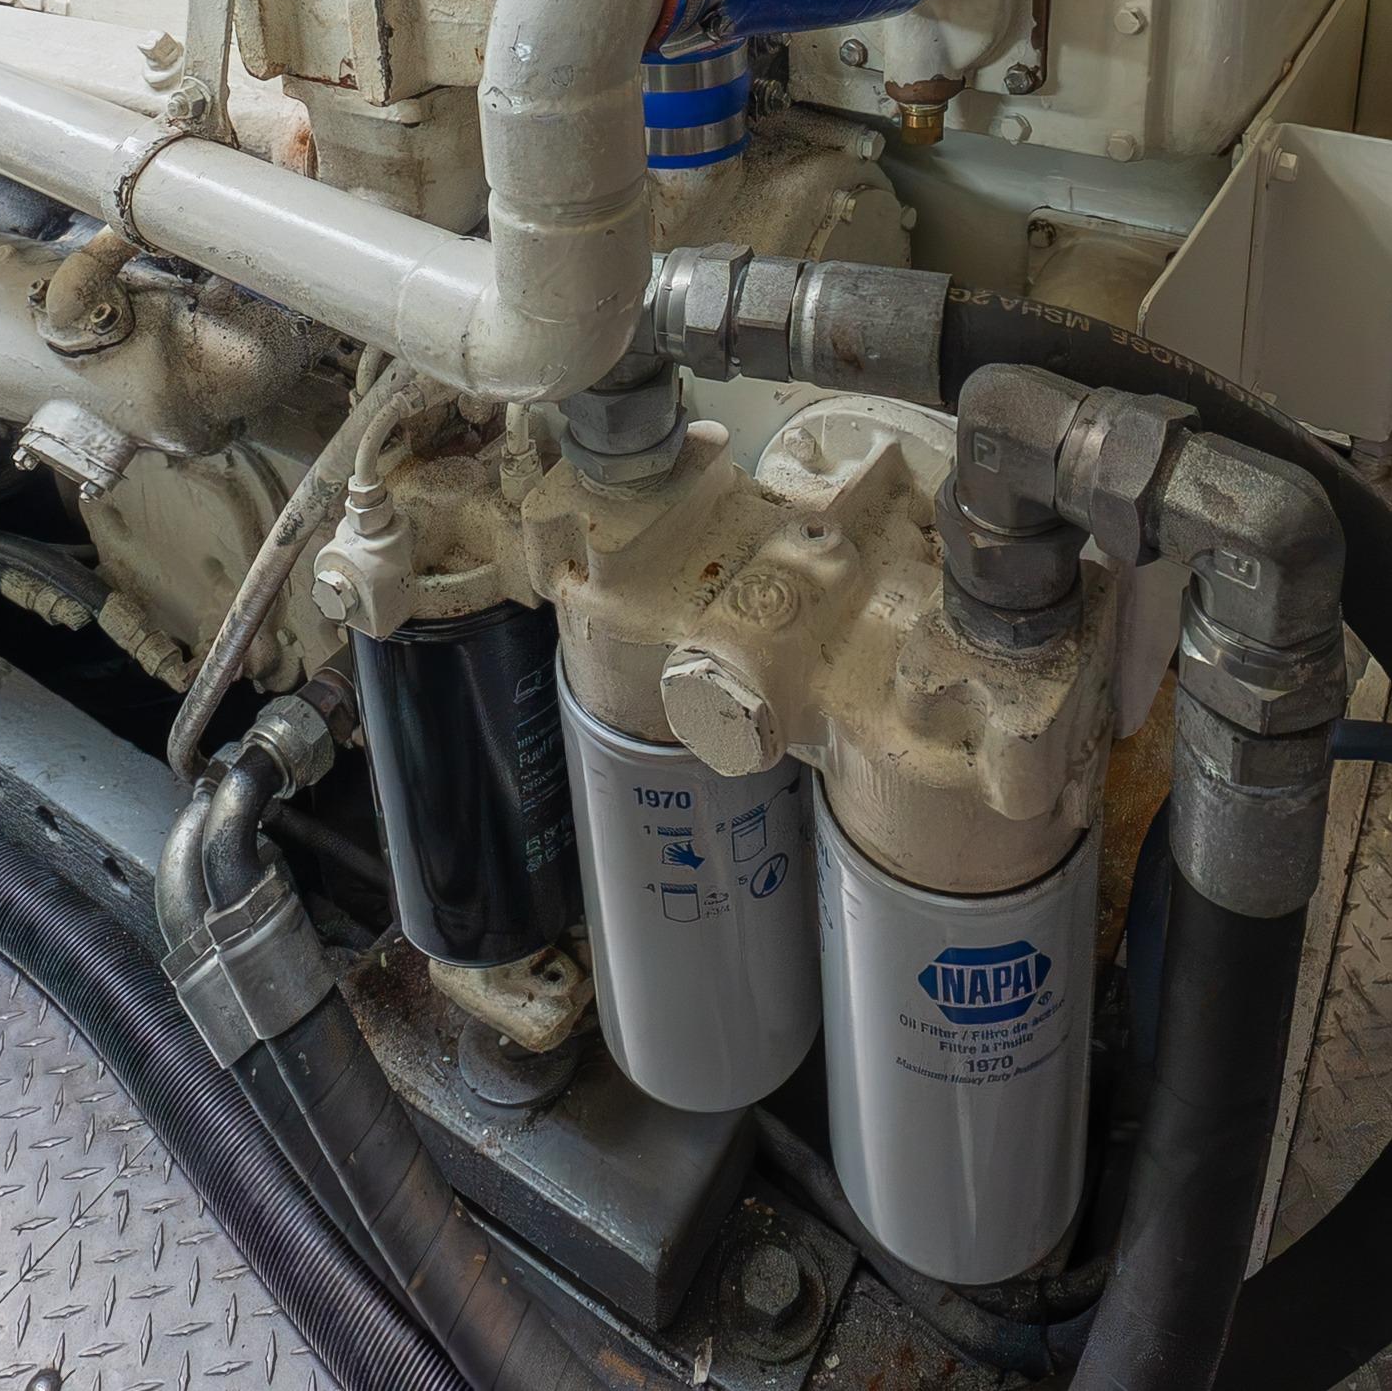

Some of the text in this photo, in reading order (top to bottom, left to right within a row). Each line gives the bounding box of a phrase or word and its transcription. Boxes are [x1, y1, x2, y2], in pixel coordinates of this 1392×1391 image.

[1000, 295, 1091, 333] MSHA
[633, 787, 692, 809] 1970
[940, 958, 1033, 1006] NAPA
[899, 1013, 917, 1030] Oil
[920, 1022, 958, 1040] Filter
[971, 1028, 1009, 1042] Filtro
[939, 1041, 978, 1055] Filtre
[965, 1055, 1014, 1073] 1970
